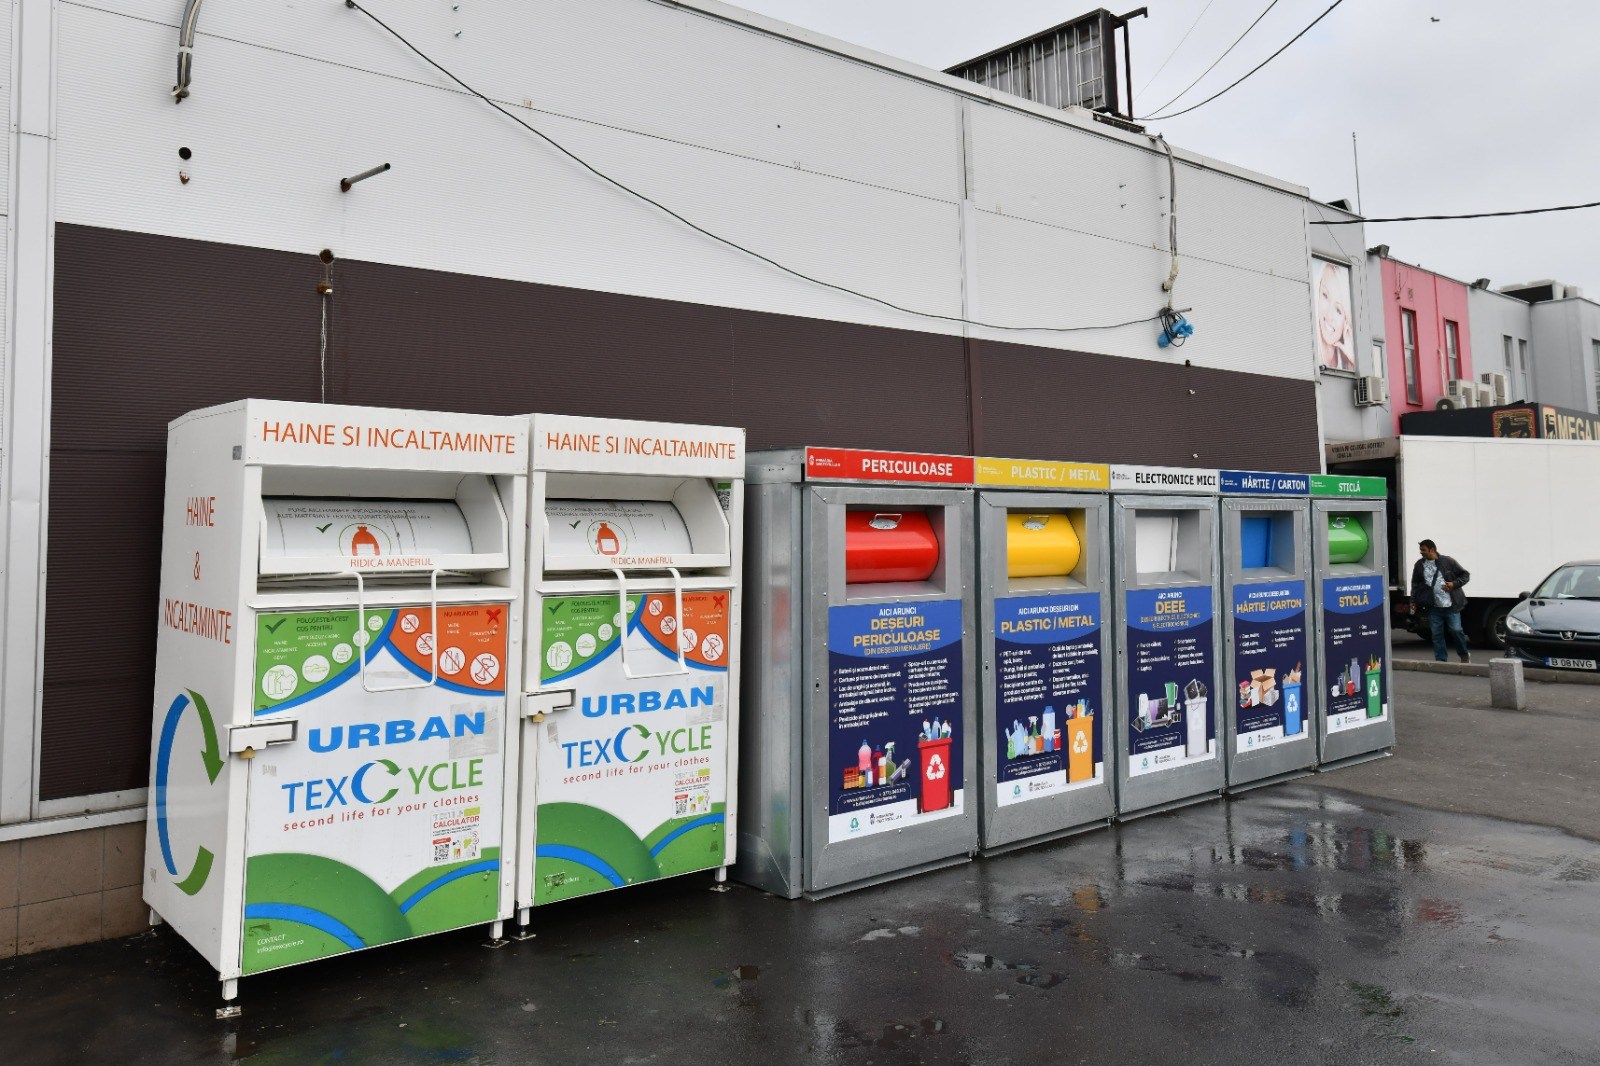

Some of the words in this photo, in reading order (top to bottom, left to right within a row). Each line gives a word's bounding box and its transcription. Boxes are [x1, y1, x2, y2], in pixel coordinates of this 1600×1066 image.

[1557, 414, 1592, 440] MEGA
[262, 421, 335, 446] HAINE
[342, 426, 360, 446] SI
[367, 428, 516, 454] INCALTAMINTE
[547, 432, 600, 452] HAINE
[605, 436, 619, 453] SI
[624, 437, 736, 460] INCALTAMINTE
[862, 458, 953, 477] PERICULOASE
[1011, 464, 1057, 480] PLASTIC
[1060, 467, 1065, 482] /
[1069, 467, 1101, 481] METAL
[1135, 472, 1194, 486] ELECTRONICE
[1197, 473, 1216, 486] MICI
[1278, 478, 1306, 491] CARTON
[186, 496, 215, 527] HAINE
[193, 551, 201, 581] &
[350, 558, 384, 568] RIDICA
[386, 558, 434, 567] MANERUL
[610, 557, 637, 565] RIDICA
[638, 556, 674, 565] MANERUL
[1155, 599, 1186, 615] DEEE
[1270, 598, 1302, 611] CARTON
[1339, 591, 1369, 608] STICLĂ
[879, 608, 892, 617] AICI
[893, 606, 917, 615] ARUNCI
[164, 598, 232, 644] INCALTAMINTE
[871, 616, 924, 632] DEȘEURI
[1001, 617, 1052, 634] PLASTIC
[1058, 615, 1095, 629] METAL
[853, 629, 941, 647] PERICULOASE
[1552, 658, 1559, 666] B
[1560, 658, 1572, 667] 08
[1572, 660, 1593, 668] NVG
[581, 686, 714, 718] URBAN
[308, 712, 485, 753] URBAN
[563, 770, 601, 784] second
[606, 768, 624, 777] life
[629, 765, 644, 774] for
[648, 762, 670, 773] your
[674, 755, 710, 767] clothes
[674, 775, 711, 786] CALCULATOR
[284, 815, 334, 831] second
[342, 810, 364, 823] life
[371, 807, 391, 817] for
[397, 801, 428, 816] your
[433, 794, 480, 808] clothes
[433, 815, 480, 829] CALCULATOR
[257, 934, 285, 946] CONTACT
